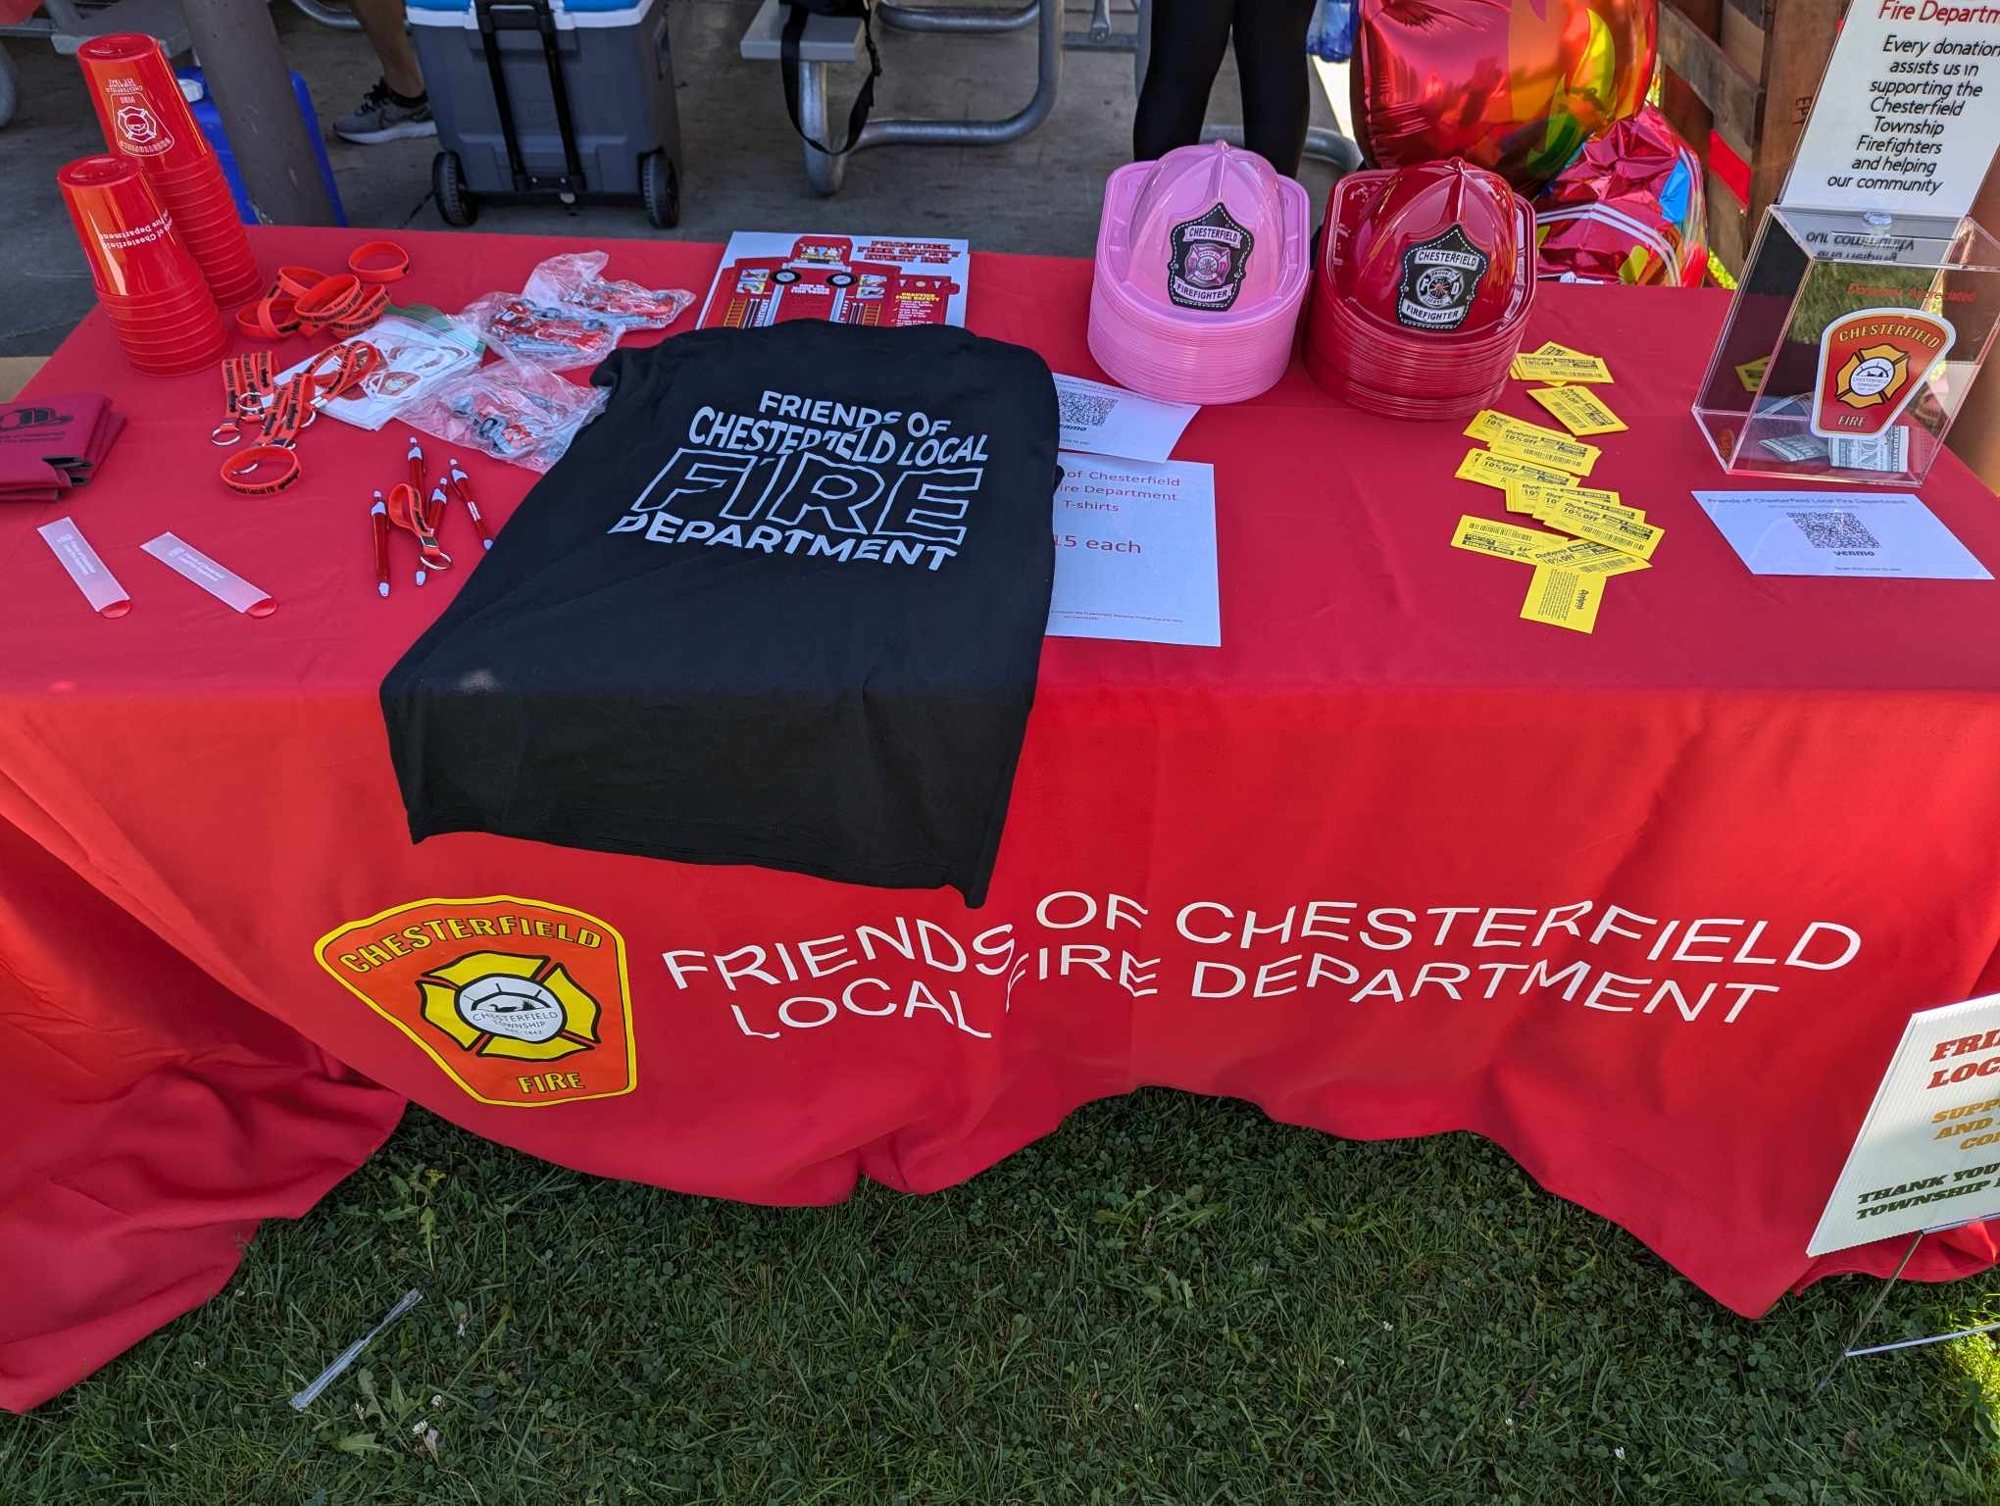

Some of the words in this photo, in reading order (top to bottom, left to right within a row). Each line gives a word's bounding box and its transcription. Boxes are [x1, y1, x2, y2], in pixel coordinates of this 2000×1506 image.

[1879, 0, 1915, 20] Fire
[1883, 34, 1930, 58] Every
[1889, 60, 1939, 74] assists
[1943, 63, 1962, 76] us
[1964, 63, 1979, 77] in
[1870, 80, 1954, 99] supporting
[1957, 81, 1983, 97] the
[1870, 96, 1966, 117] Chesterfield
[1873, 116, 1944, 136] Township
[1856, 135, 1943, 155] Firefighters
[1852, 156, 1882, 171] and
[1883, 158, 1937, 177] helping
[1827, 175, 1852, 188] our
[1857, 176, 1943, 196] community
[1189, 227, 1238, 243] CHESTERFIELD
[1418, 251, 1477, 267] CHESTERFIELD
[1177, 282, 1228, 300] FIREFIGHTER
[1406, 305, 1459, 321] FIREFIGHTER
[1838, 323, 1941, 348] CHESTERFIELD
[758, 390, 902, 433] FRIENDS
[907, 411, 952, 438] OF
[1838, 415, 1866, 427] FIRE
[897, 434, 989, 466] LOCAL
[1067, 470, 1083, 478] of
[1089, 471, 1180, 487] Chesterfield
[630, 448, 983, 545] FIRE
[1060, 483, 1079, 493] ire
[1084, 485, 1177, 501] Department
[1064, 500, 1120, 512] T-shirts
[607, 512, 957, 571] DEPARTMENT
[1086, 539, 1141, 553] each
[338, 915, 602, 974] CHESTERFIELD
[662, 917, 1013, 991] FRIENDS
[1036, 890, 1148, 931] OF
[1176, 900, 1861, 971] CHESTERFIELD
[731, 978, 992, 1039] LOCAL
[1006, 943, 1161, 1013] FIRE
[1194, 954, 1780, 1024] DEPARTMENT
[473, 1011, 558, 1022] CHESTERFIELD
[1929, 1029, 2000, 1062] FRI
[516, 1072, 586, 1096] FIRE
[1932, 1117, 1994, 1140] AND
[1858, 1174, 1948, 1205] THANK
[1953, 1162, 2000, 1182] YOU
[1857, 1180, 1991, 1220] TOWNSHIP
